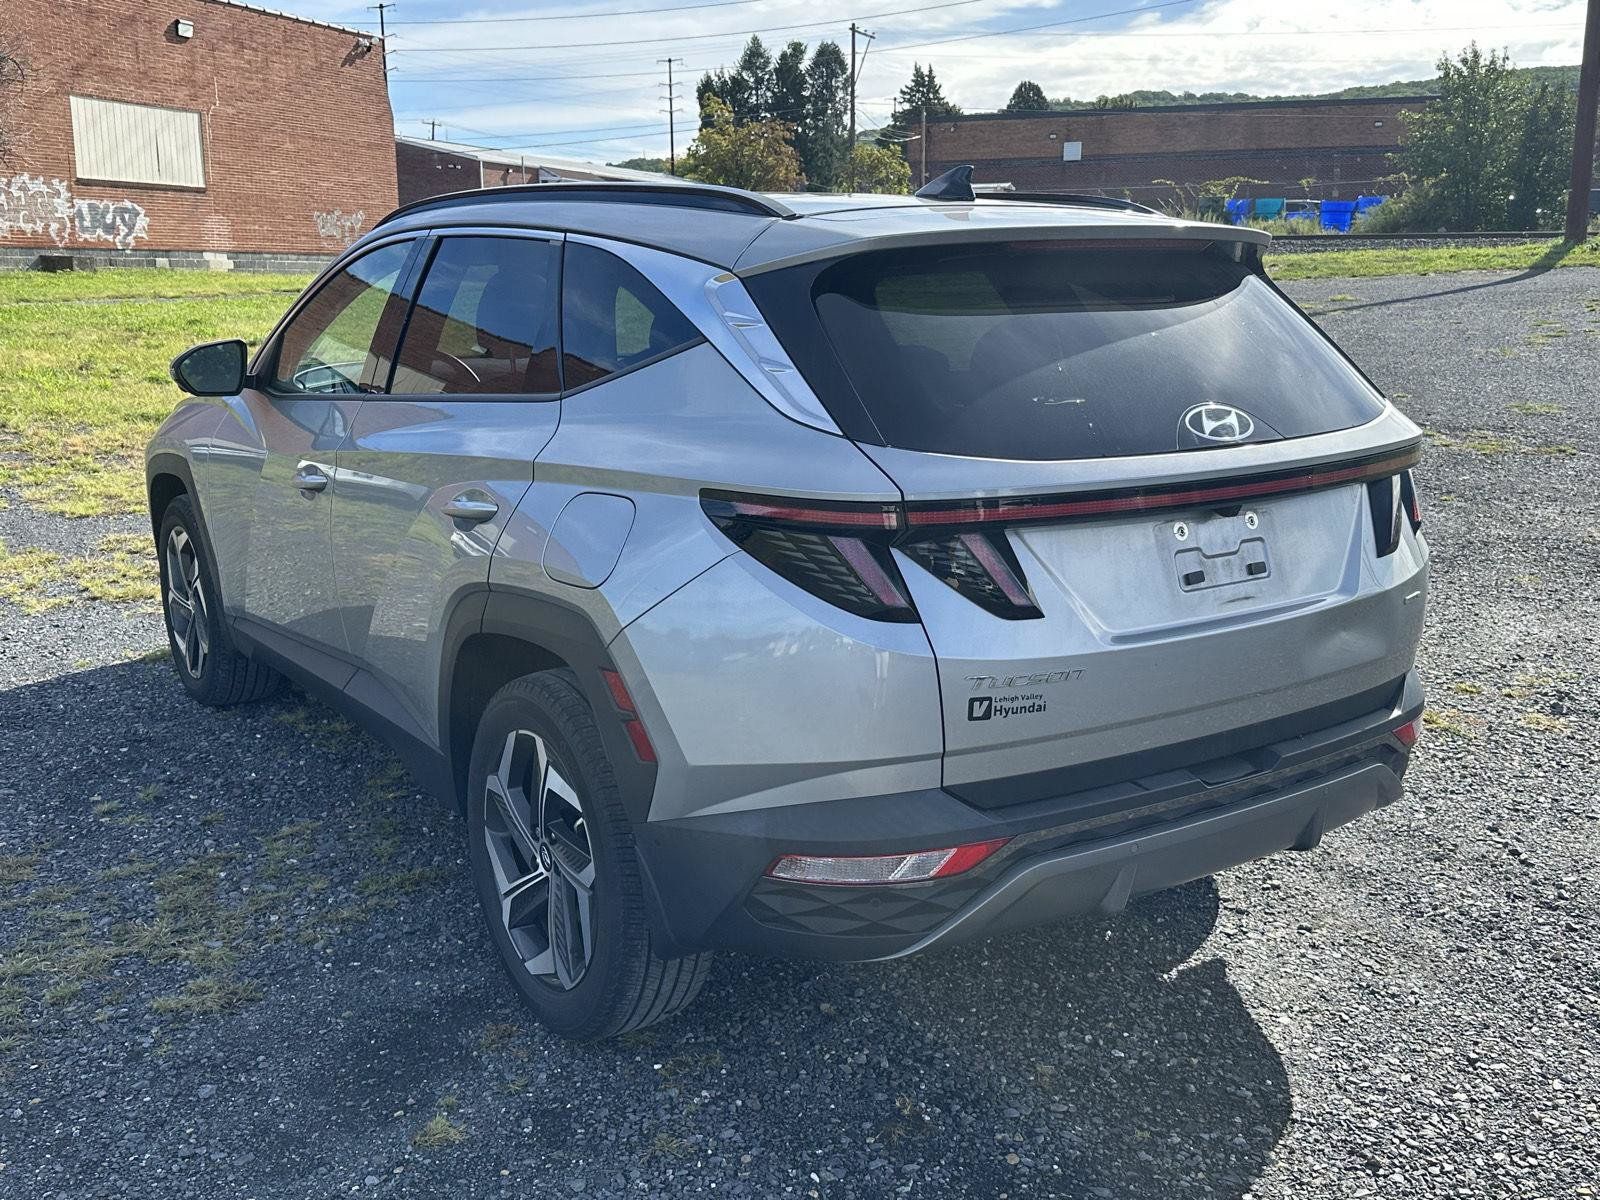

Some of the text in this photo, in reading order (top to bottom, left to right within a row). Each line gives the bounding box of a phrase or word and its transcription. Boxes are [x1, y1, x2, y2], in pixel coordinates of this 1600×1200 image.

[994, 693, 1043, 703] Lehigh Valley
[993, 700, 1047, 718] Hyundai
